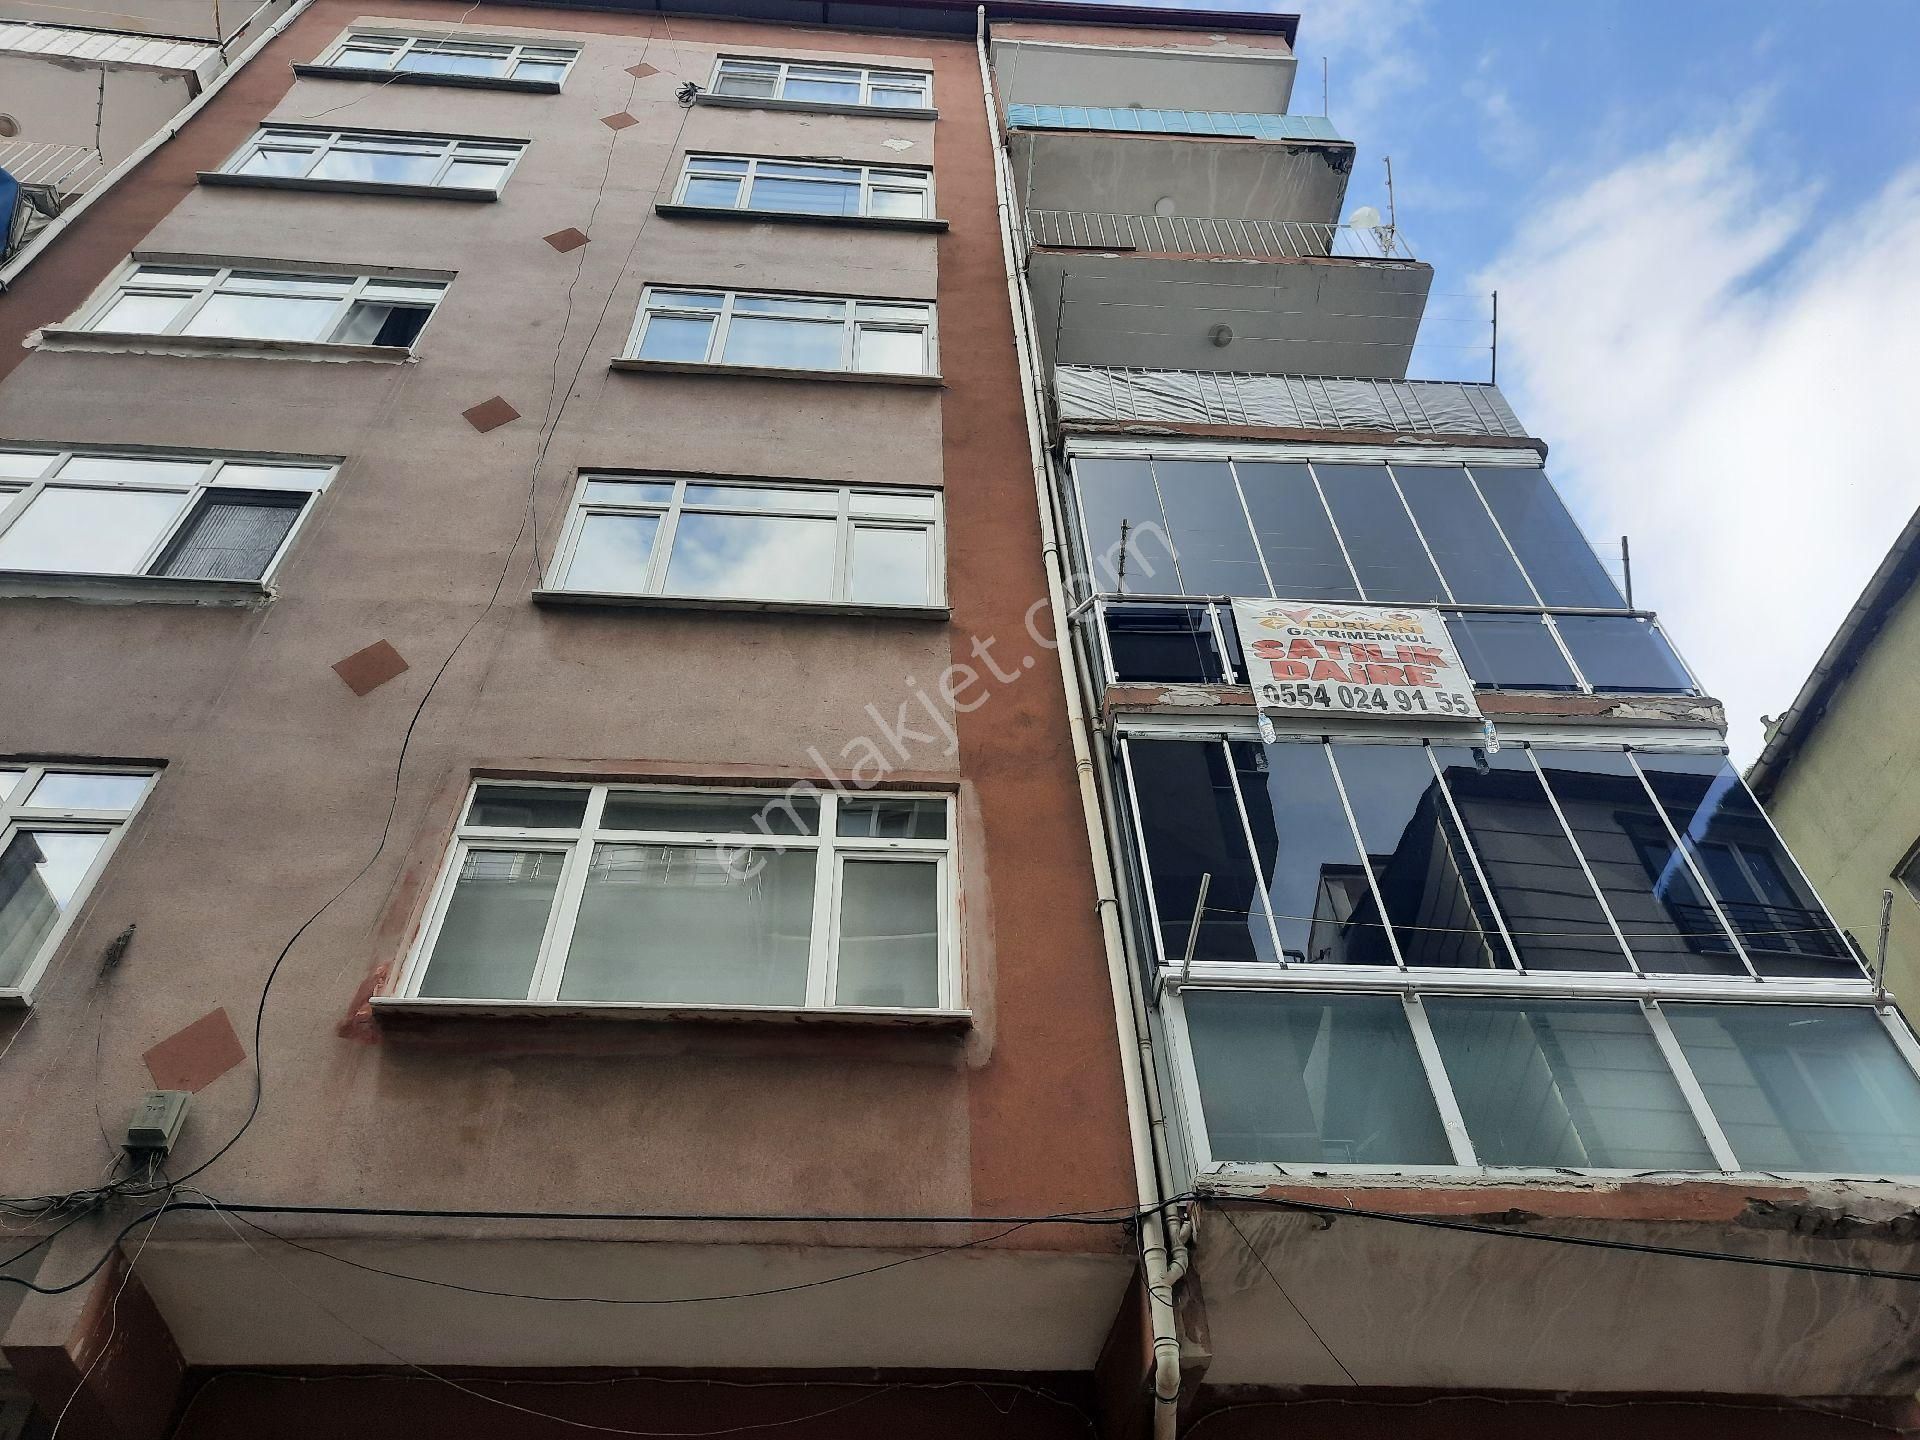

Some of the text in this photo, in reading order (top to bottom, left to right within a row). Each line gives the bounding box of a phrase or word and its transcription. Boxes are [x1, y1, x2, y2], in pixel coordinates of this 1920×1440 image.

[1251, 638, 1451, 669] SATILIK
[1262, 683, 1470, 714] 0554 024 91 55
